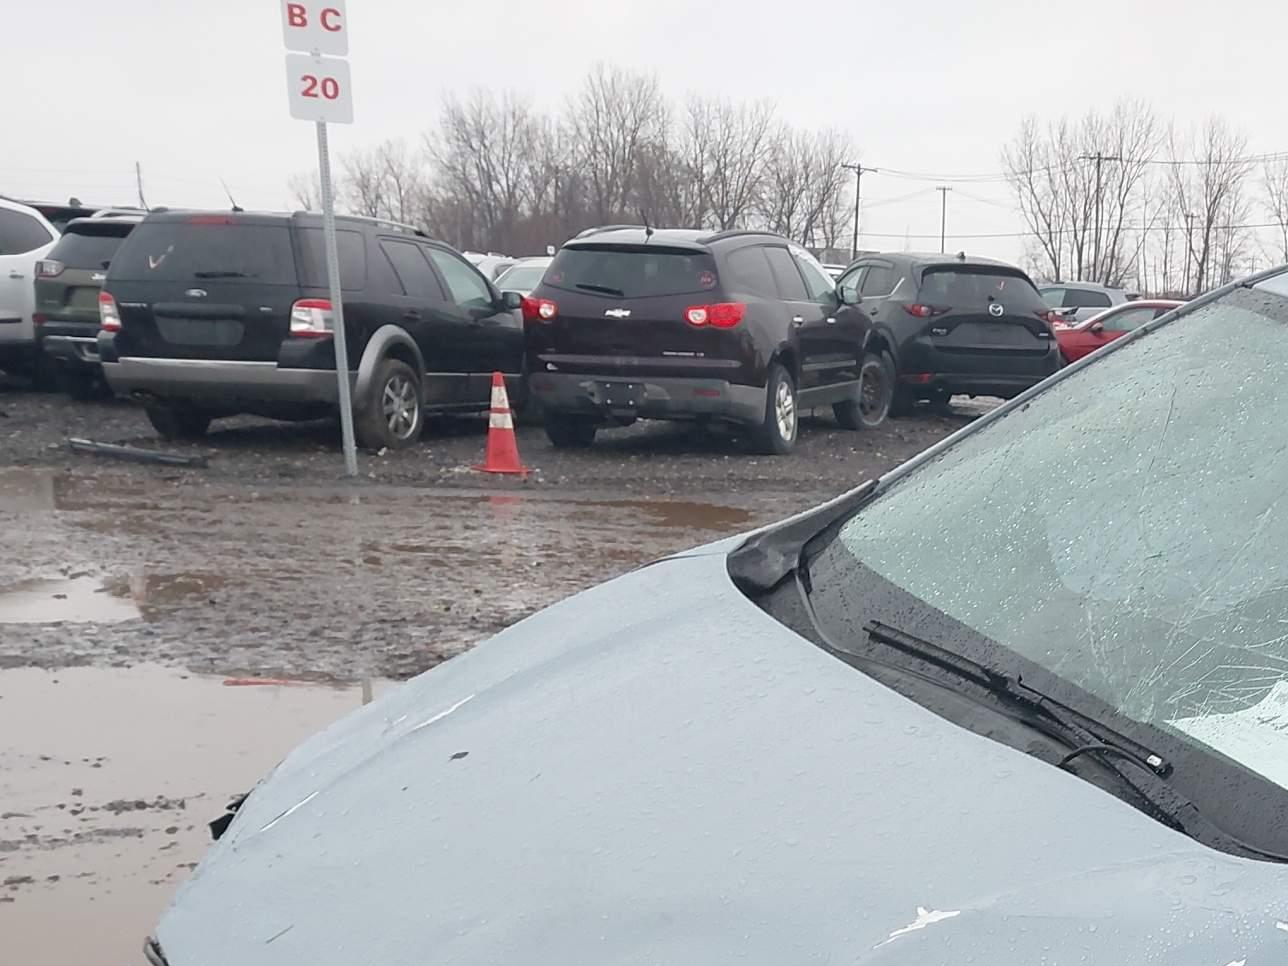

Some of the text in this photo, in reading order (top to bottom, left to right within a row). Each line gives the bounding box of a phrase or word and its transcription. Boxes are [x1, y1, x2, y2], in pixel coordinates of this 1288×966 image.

[287, 3, 342, 32] B C
[301, 75, 339, 100] 20
